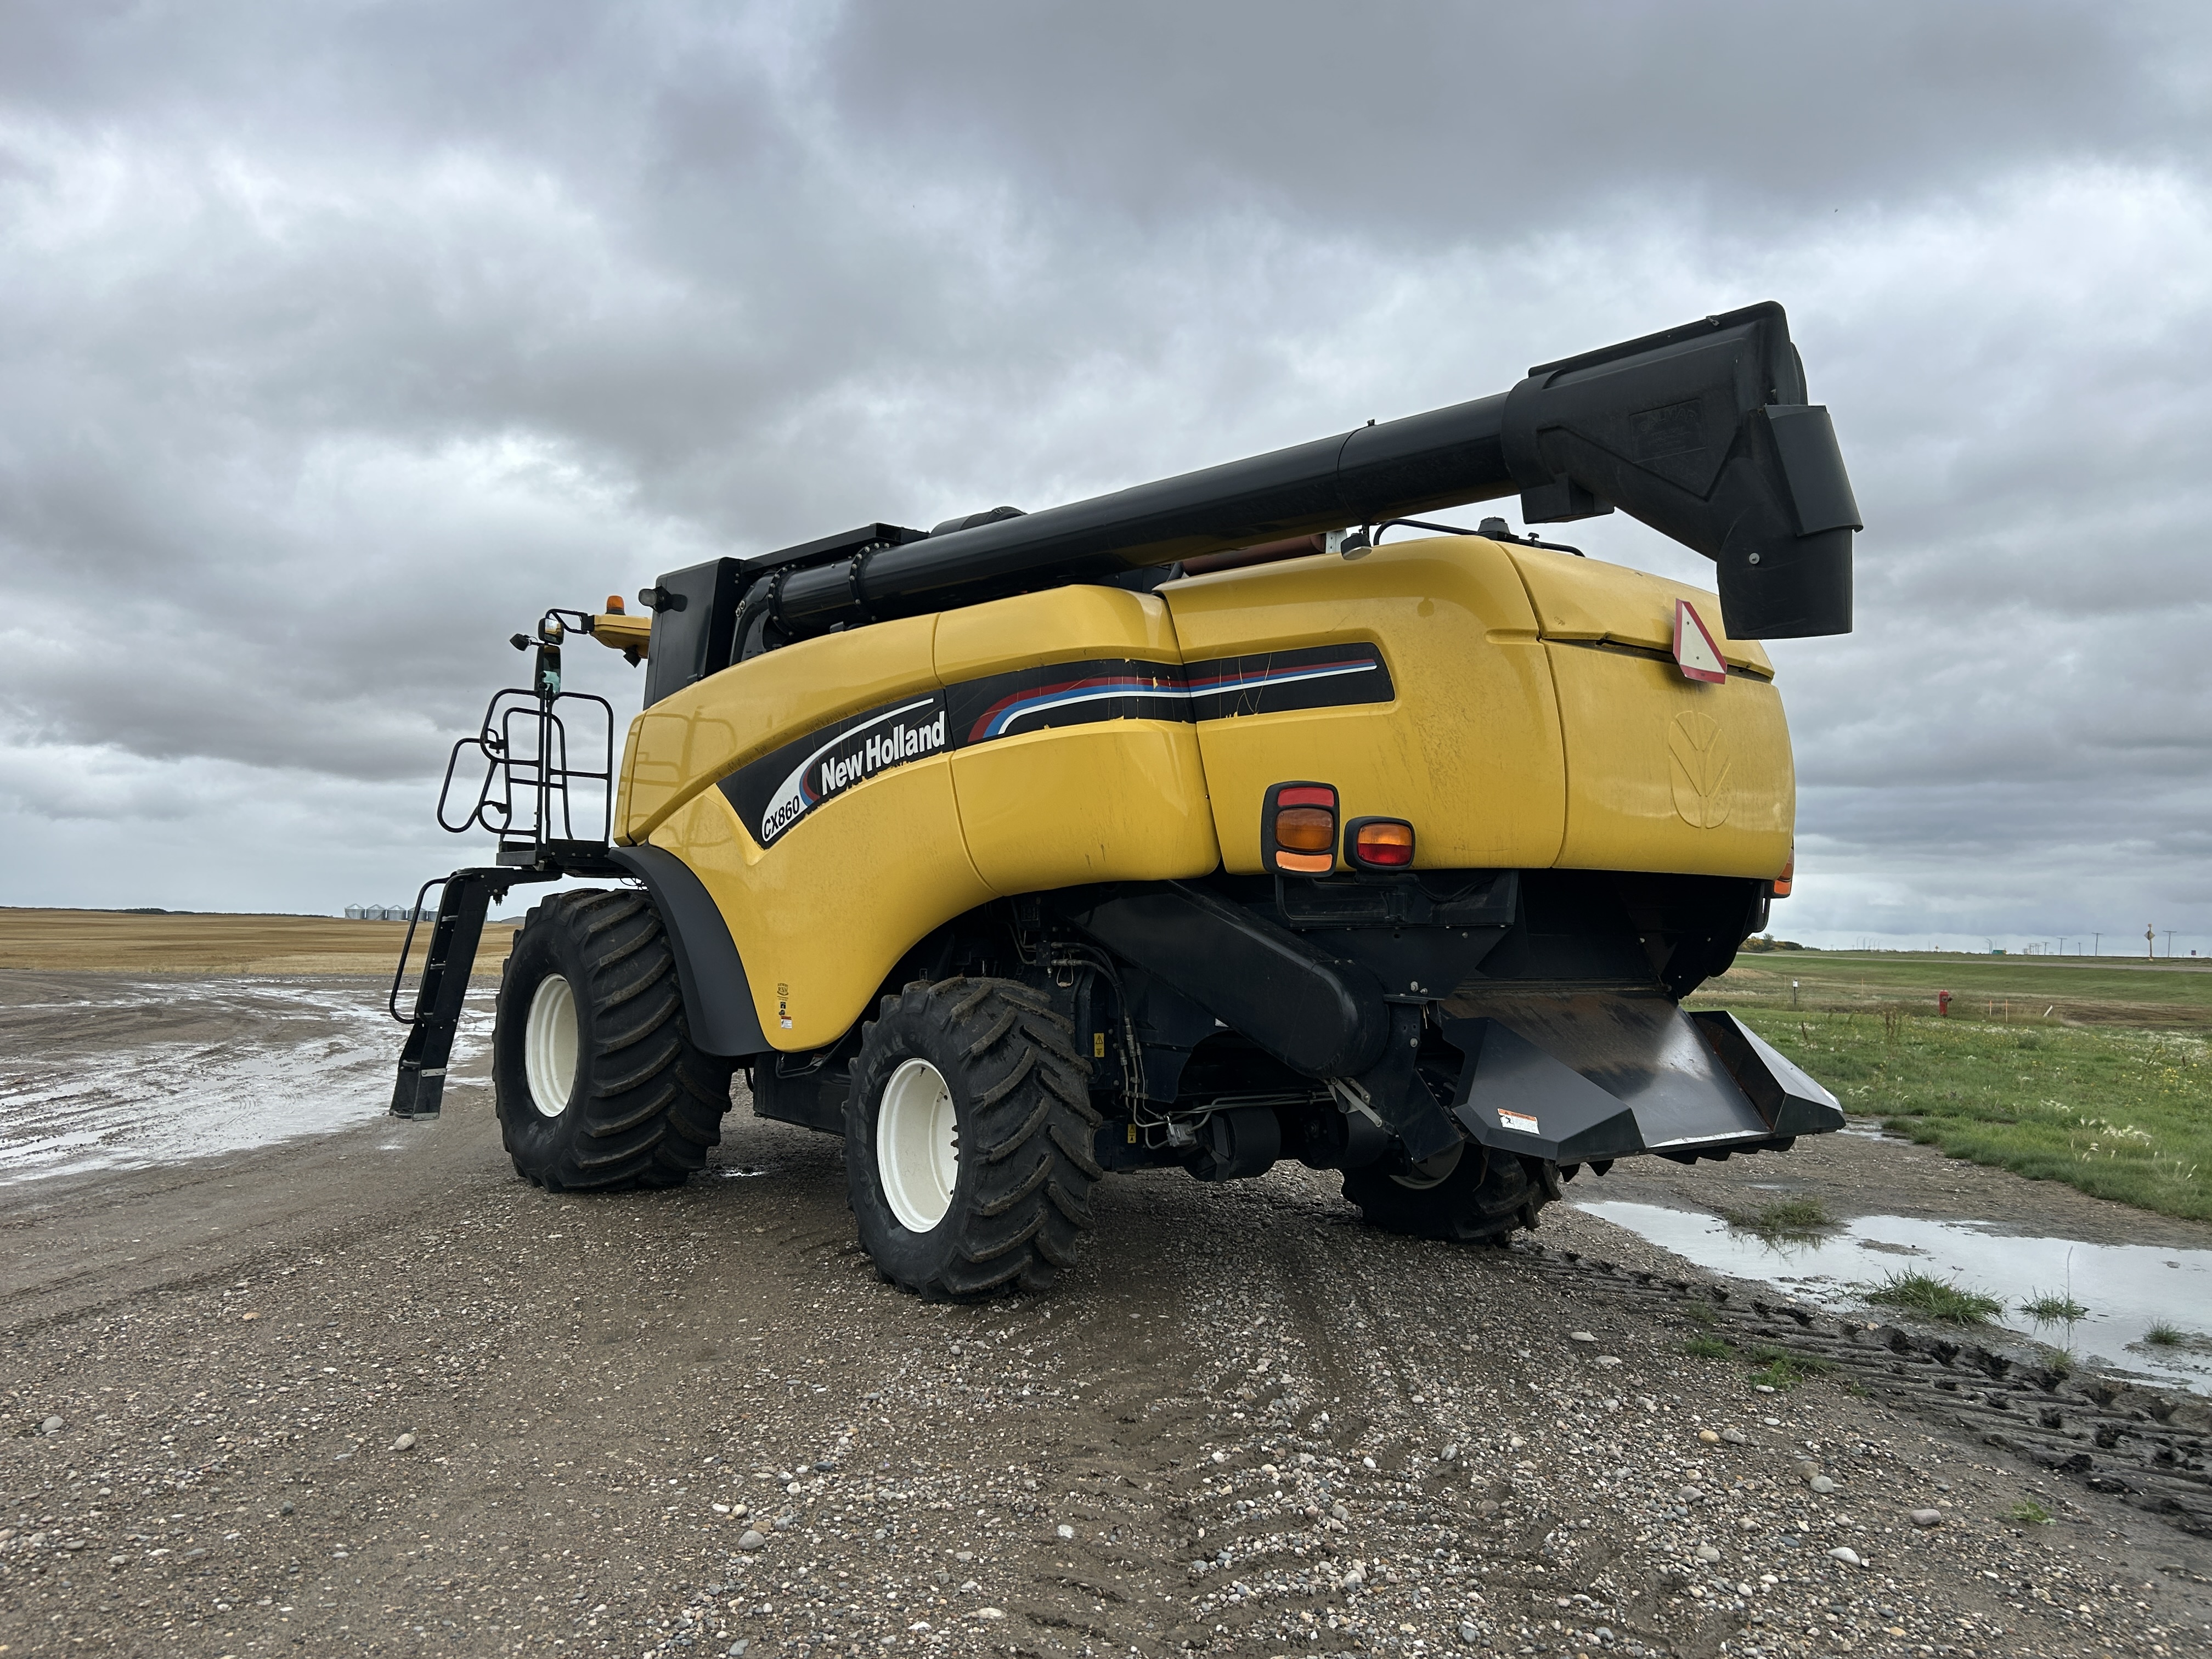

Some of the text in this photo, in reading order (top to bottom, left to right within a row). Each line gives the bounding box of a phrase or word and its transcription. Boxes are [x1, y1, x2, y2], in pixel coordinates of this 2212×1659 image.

[821, 710, 945, 795] New Holland
[764, 795, 800, 839] CX860
